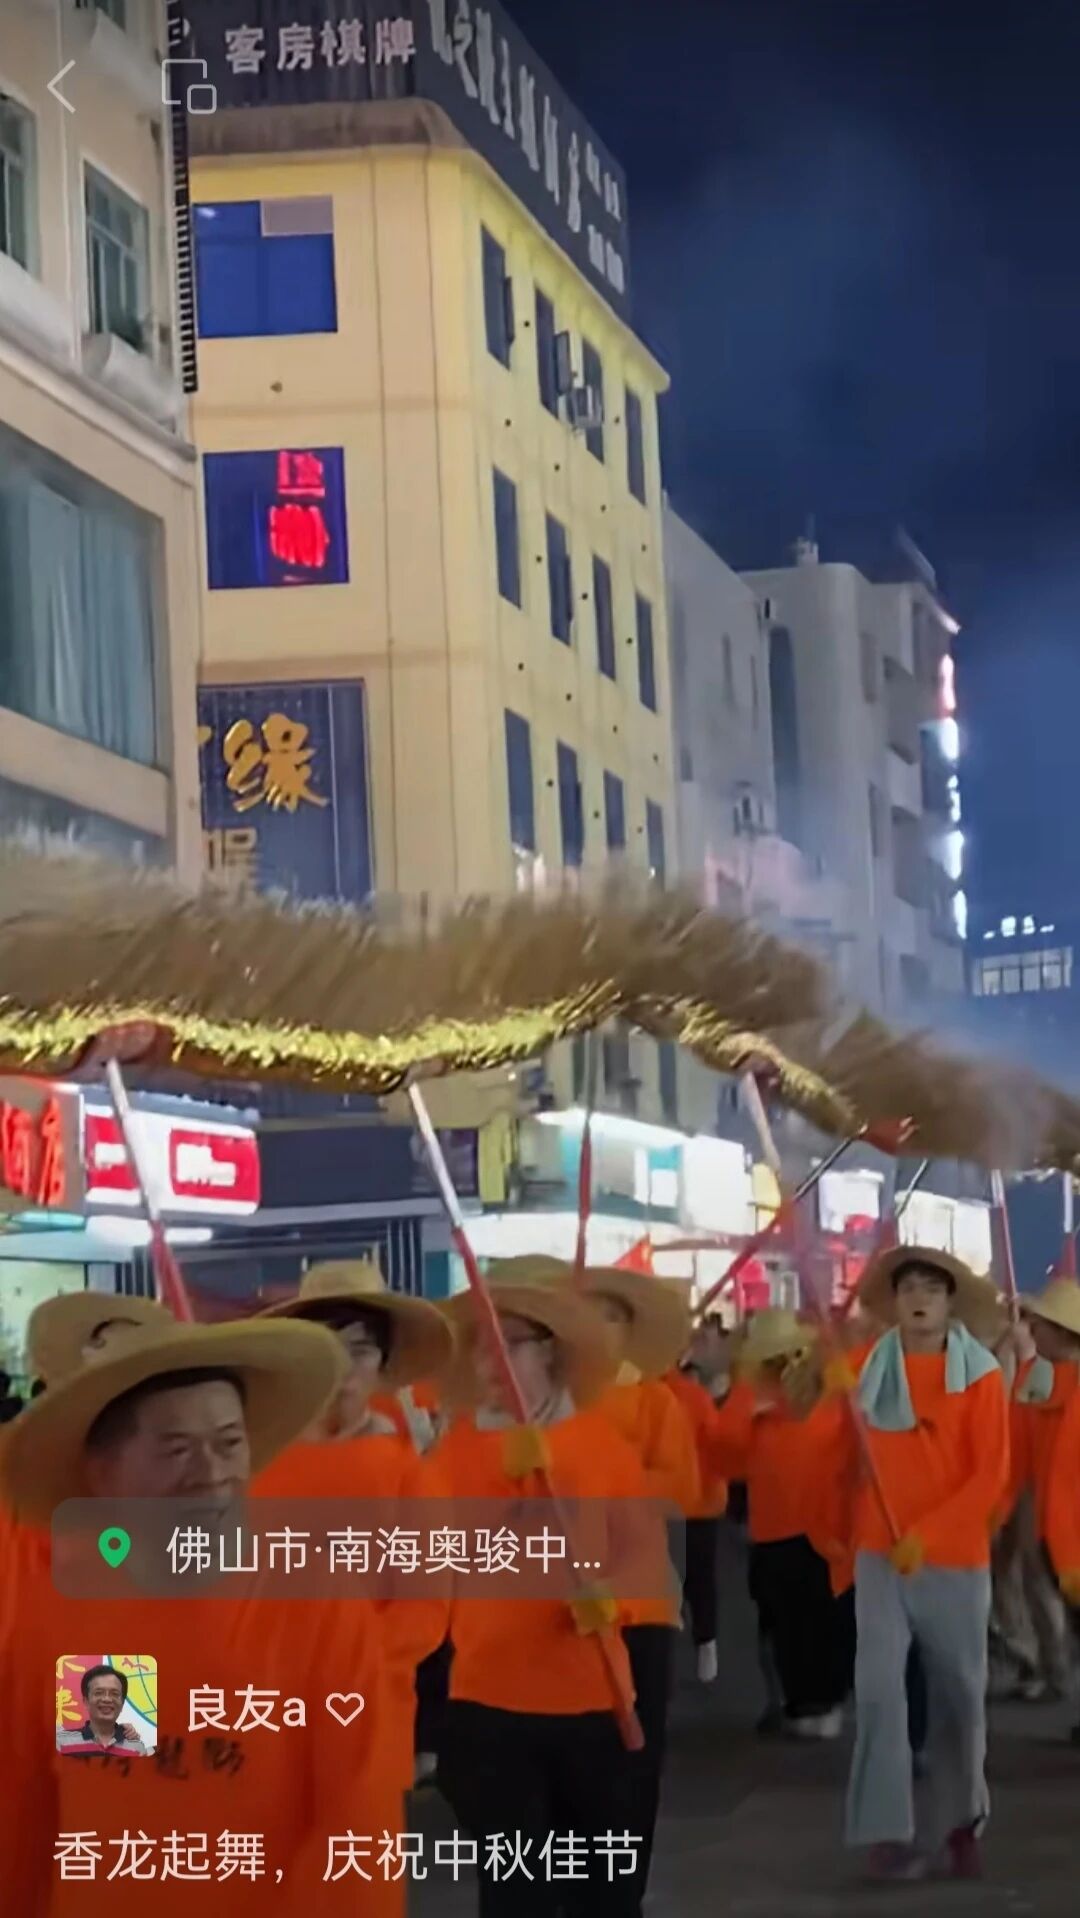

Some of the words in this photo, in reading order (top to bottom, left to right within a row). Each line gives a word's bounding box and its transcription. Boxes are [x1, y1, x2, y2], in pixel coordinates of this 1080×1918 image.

[225, 18, 416, 74] 客房棋牌
[198, 713, 328, 812] 缘
